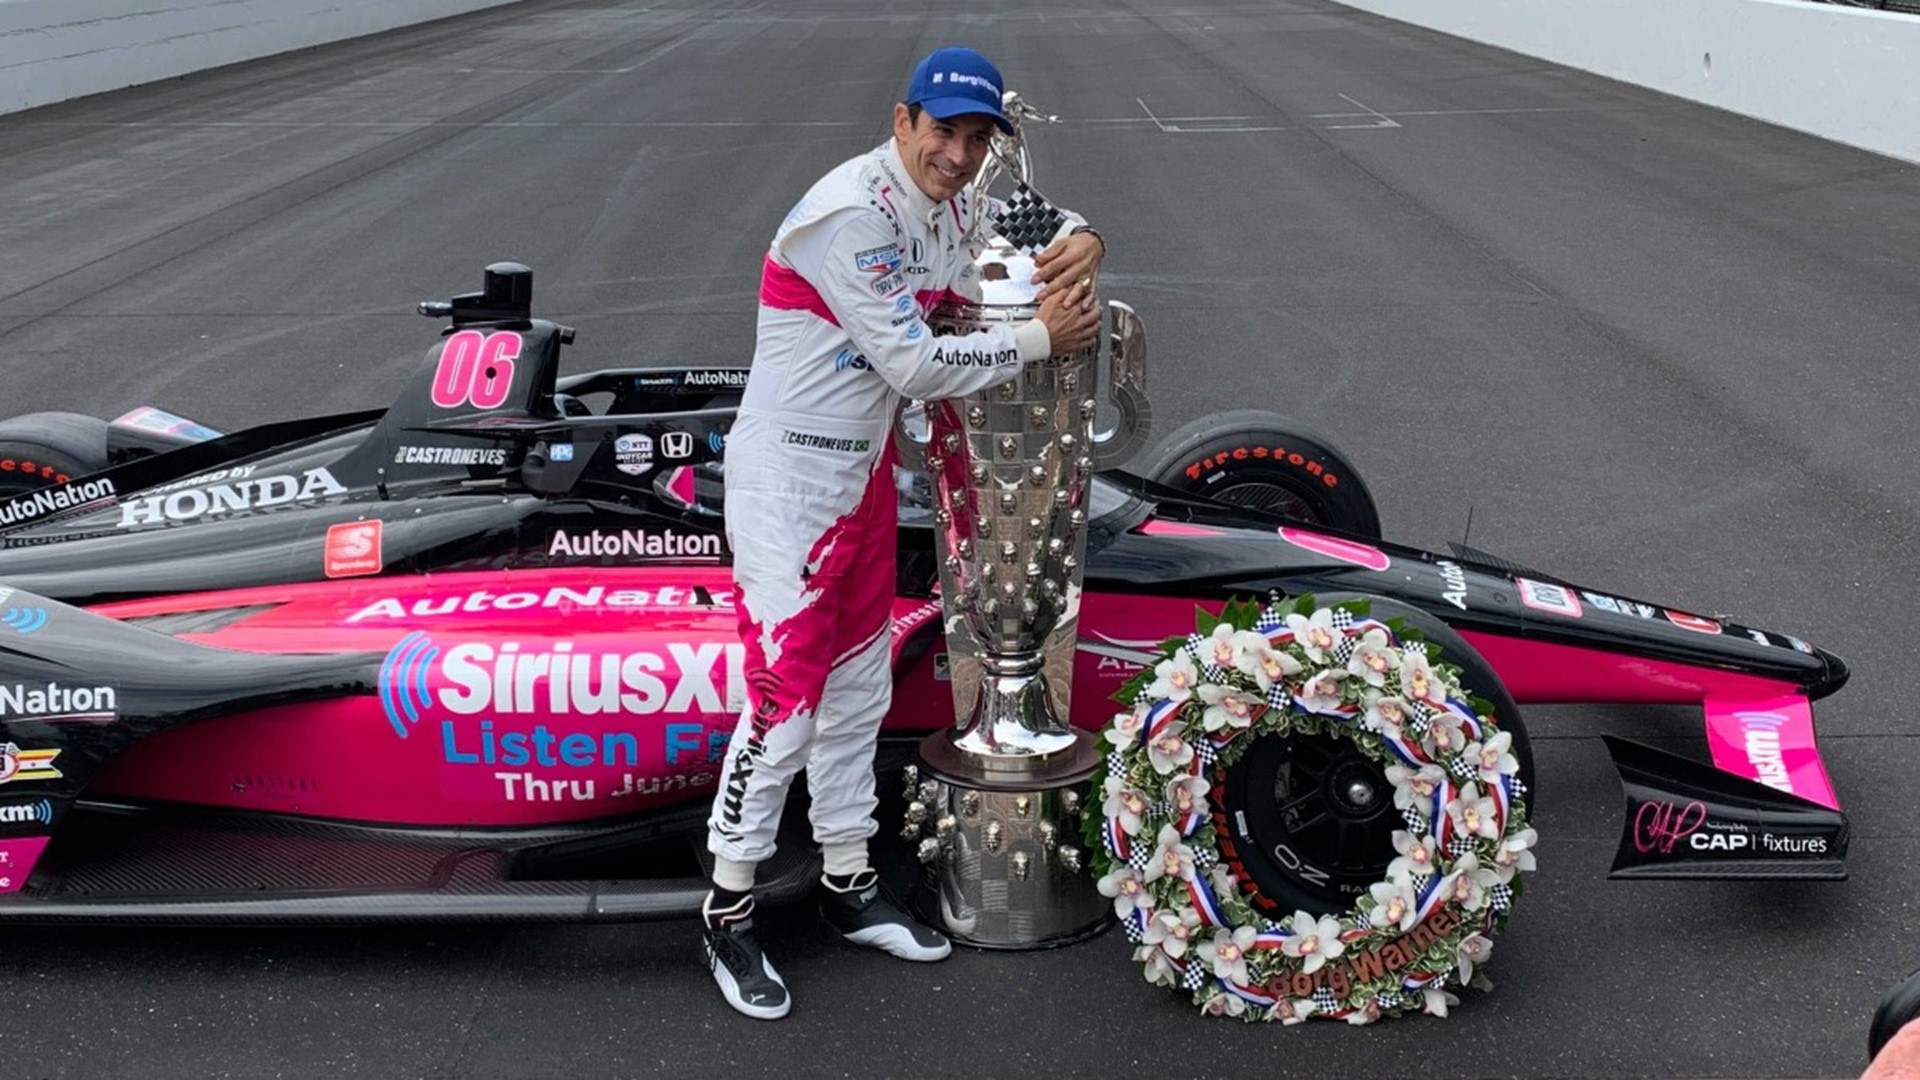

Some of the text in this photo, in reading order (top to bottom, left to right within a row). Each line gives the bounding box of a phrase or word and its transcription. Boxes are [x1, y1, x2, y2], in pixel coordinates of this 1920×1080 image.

[431, 331, 523, 409] 06
[932, 348, 1017, 367] AutoNaion
[405, 447, 506, 465] CASTRONEVES
[788, 432, 853, 451] CASTRONEVES
[1185, 446, 1338, 488] Firestone
[116, 466, 348, 527] HONDA
[549, 529, 720, 556] AutoNation
[441, 720, 637, 767] Listen
[495, 772, 713, 801] Thru June
[1690, 833, 1827, 852] CAP fixtures
[1268, 910, 1461, 999] Borg Warner
